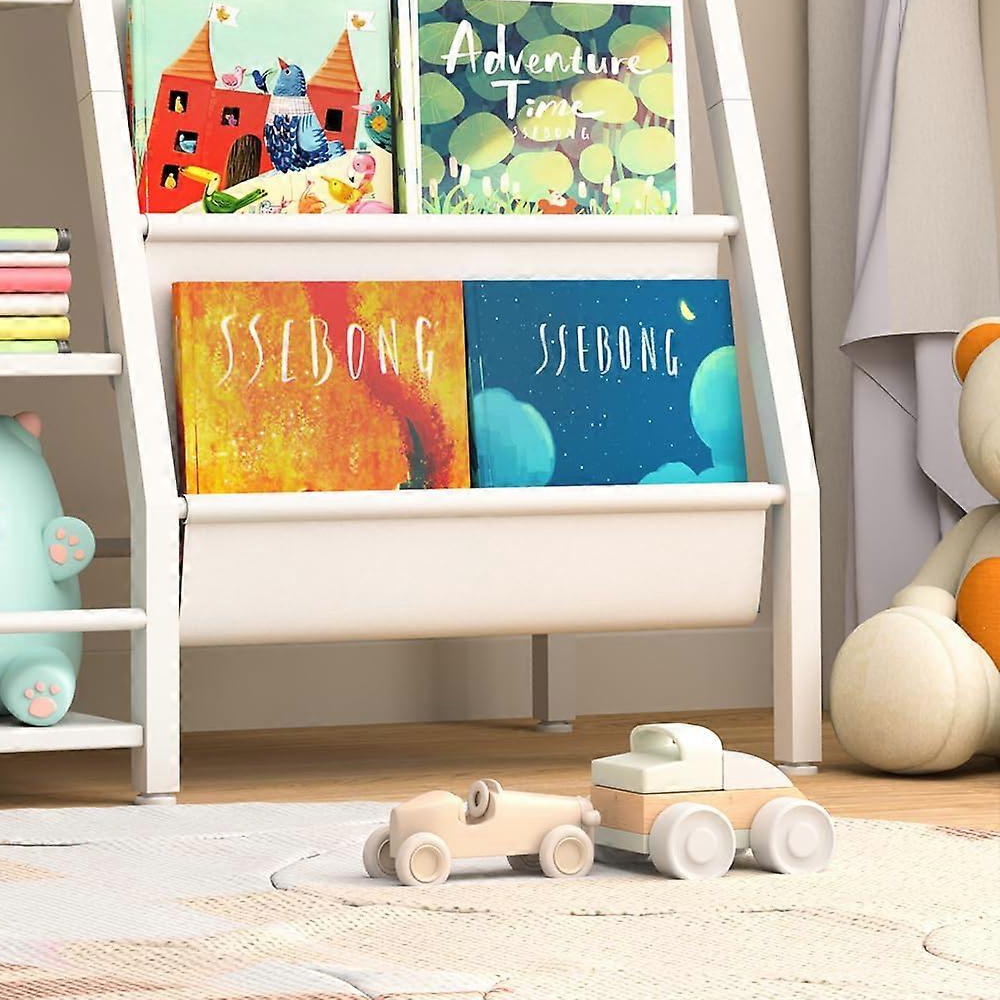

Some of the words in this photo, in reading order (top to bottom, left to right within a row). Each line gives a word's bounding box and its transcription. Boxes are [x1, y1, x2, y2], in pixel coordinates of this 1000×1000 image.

[440, 19, 654, 75] Adventure
[490, 79, 606, 120] Time
[217, 313, 434, 386] SSEBONG
[535, 323, 678, 378] SSEBONG
